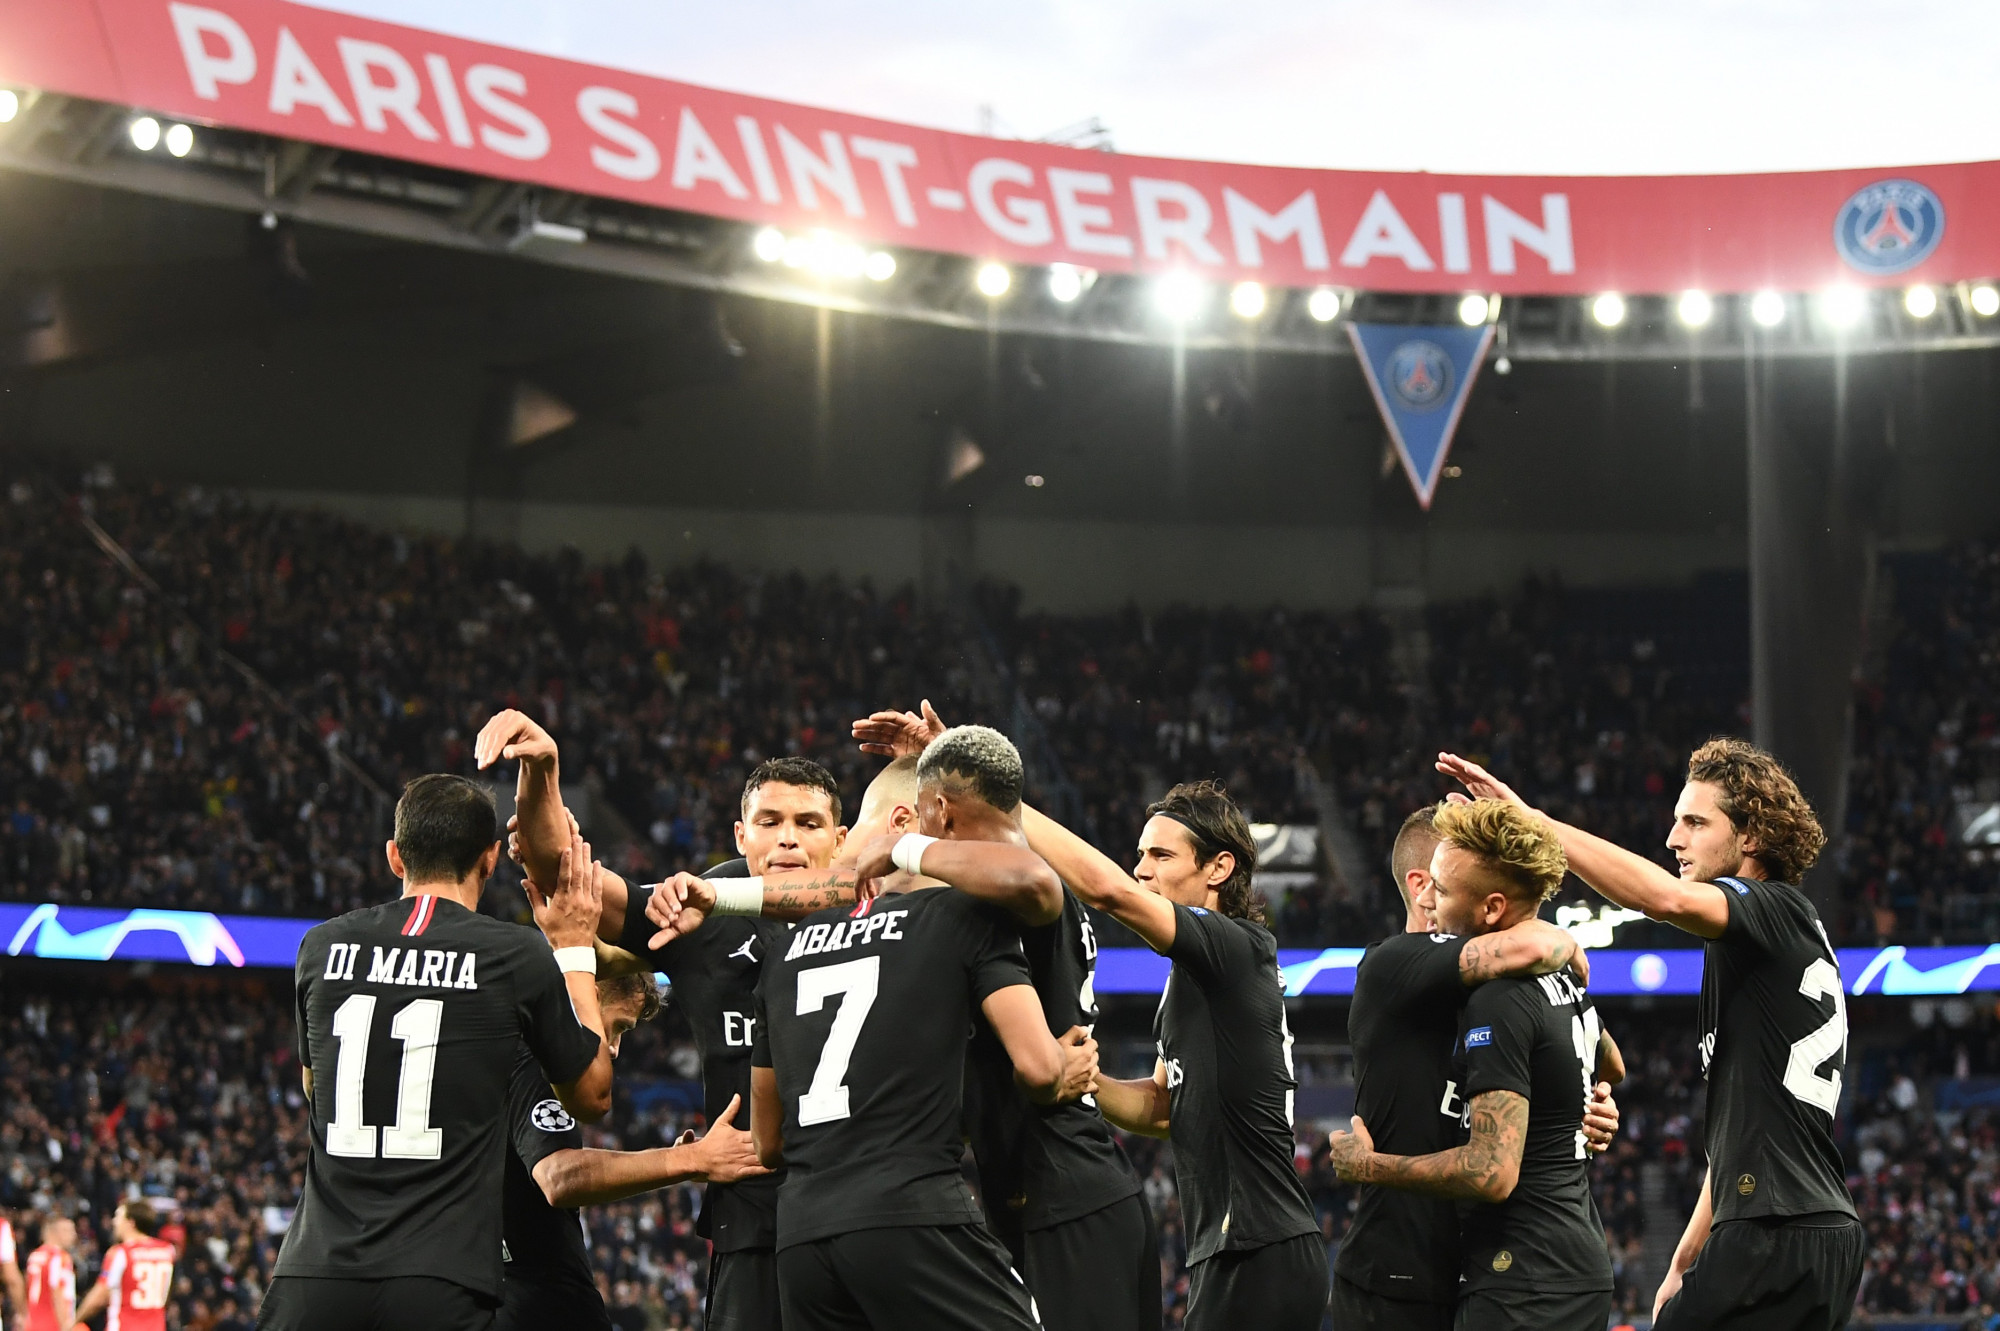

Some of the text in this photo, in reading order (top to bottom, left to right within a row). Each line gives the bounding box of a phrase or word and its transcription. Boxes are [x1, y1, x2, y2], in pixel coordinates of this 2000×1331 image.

[168, 2, 1577, 276] PARIS SAINT-GERMAIN
[323, 943, 478, 990] DI MARIA
[784, 910, 907, 962] MBAPPE
[326, 993, 444, 1160] 11
[796, 956, 880, 1127] 7
[1783, 957, 1849, 1121] 2
